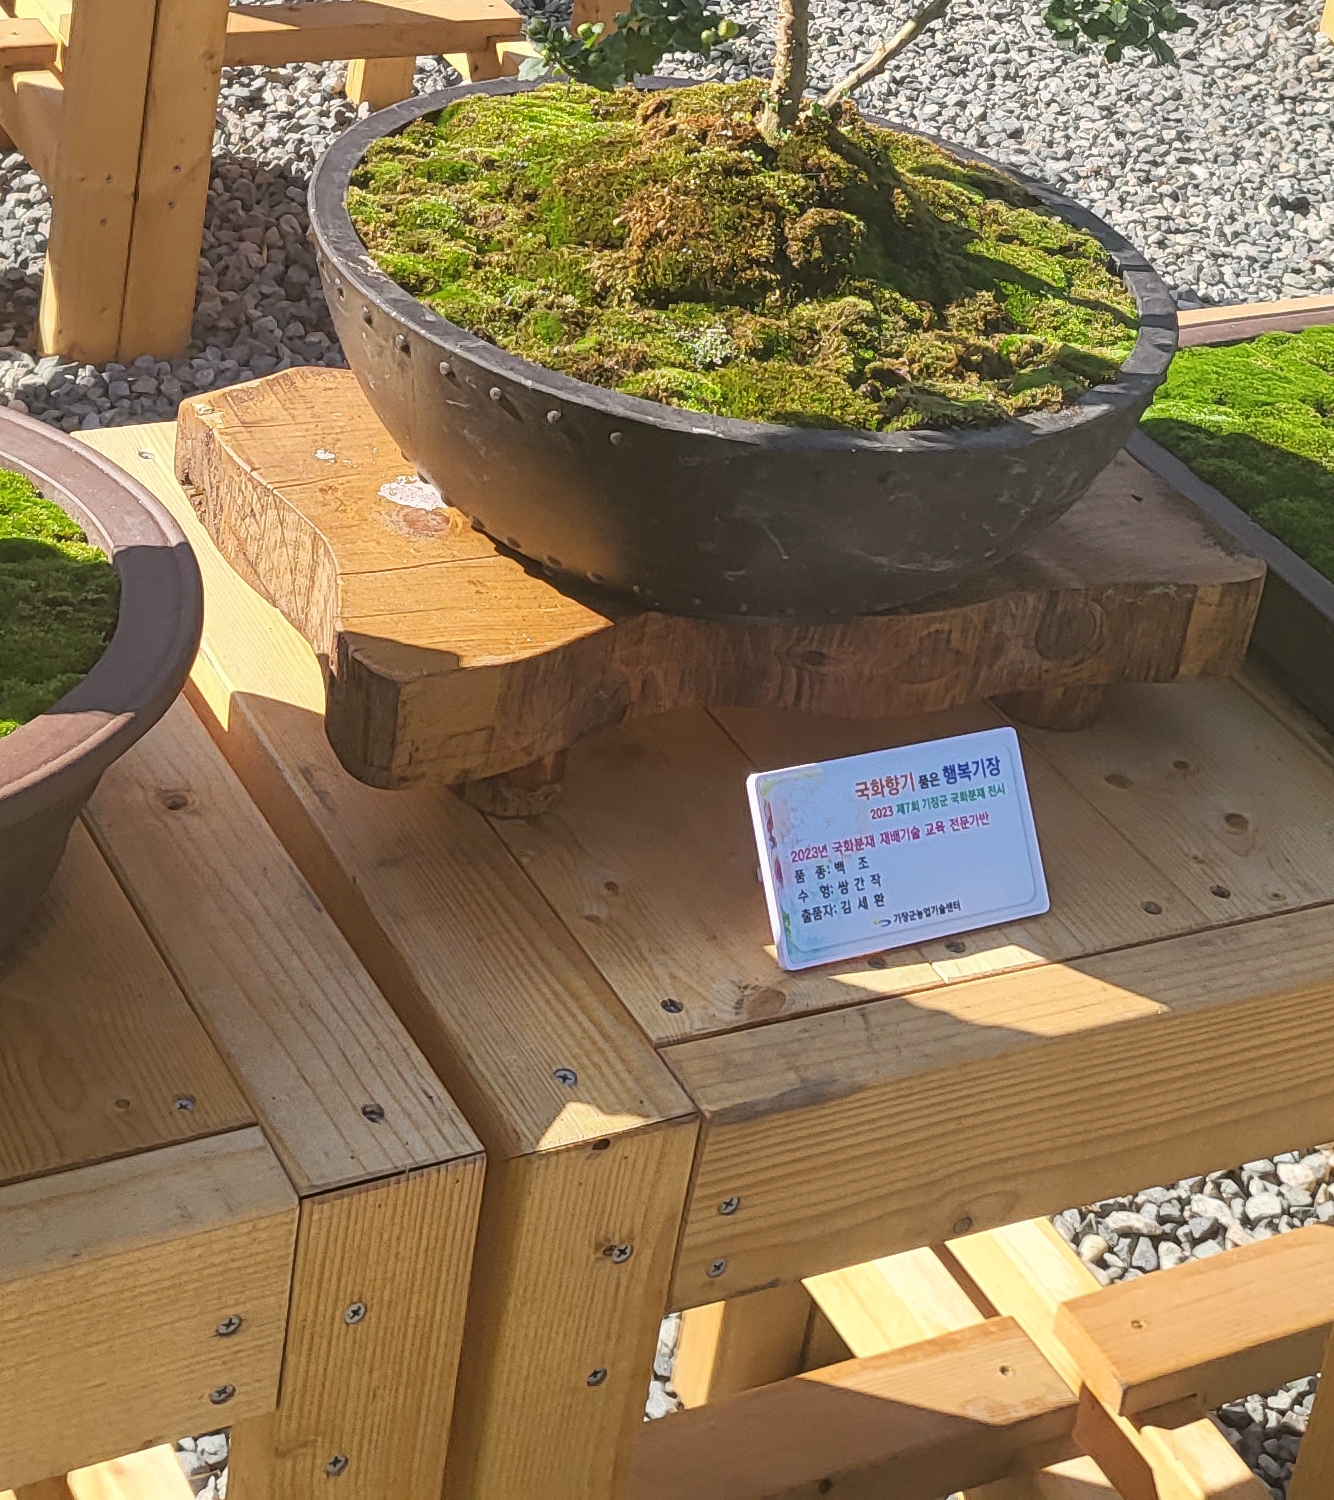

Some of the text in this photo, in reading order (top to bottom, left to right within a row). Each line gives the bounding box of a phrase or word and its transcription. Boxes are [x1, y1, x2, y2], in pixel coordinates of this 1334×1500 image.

[854, 755, 1001, 801] 국화향기 품은 행복기장
[870, 782, 1006, 820] 2023 제7회 기장군 국화분재 전시
[790, 811, 990, 863] 2023년 국화분재 재배기술 교육 전문가반
[892, 899, 962, 925] 기장군농업기술센터
